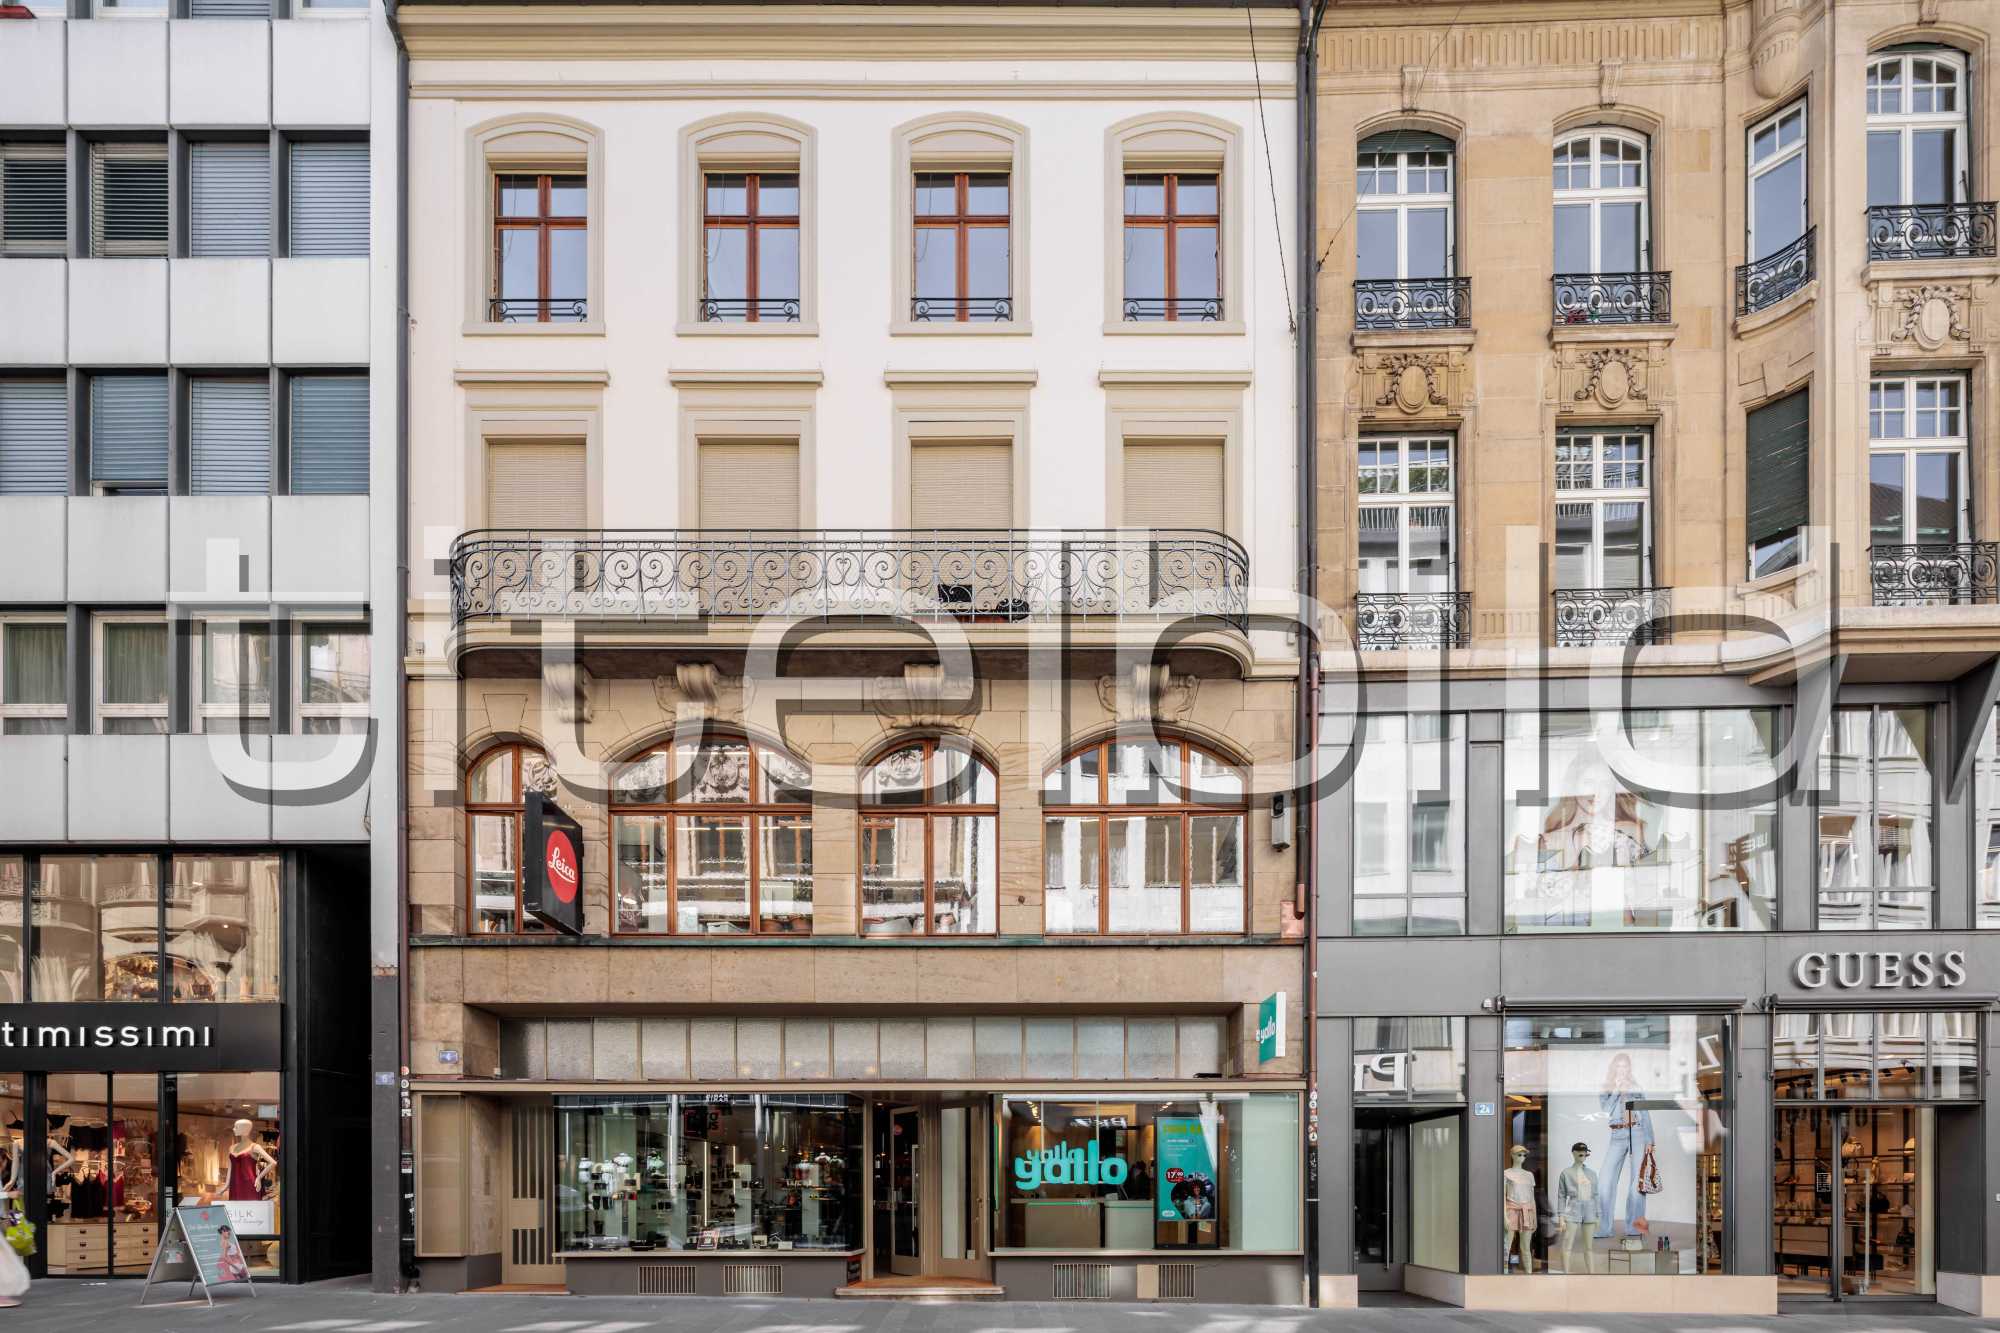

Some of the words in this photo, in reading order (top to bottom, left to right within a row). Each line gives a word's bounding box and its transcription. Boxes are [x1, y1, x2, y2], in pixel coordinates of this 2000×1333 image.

[547, 846, 576, 884] Leica
[1796, 950, 1967, 988] GUESS
[1259, 1015, 1276, 1044] yallo
[1014, 1139, 1128, 1191] yallo
